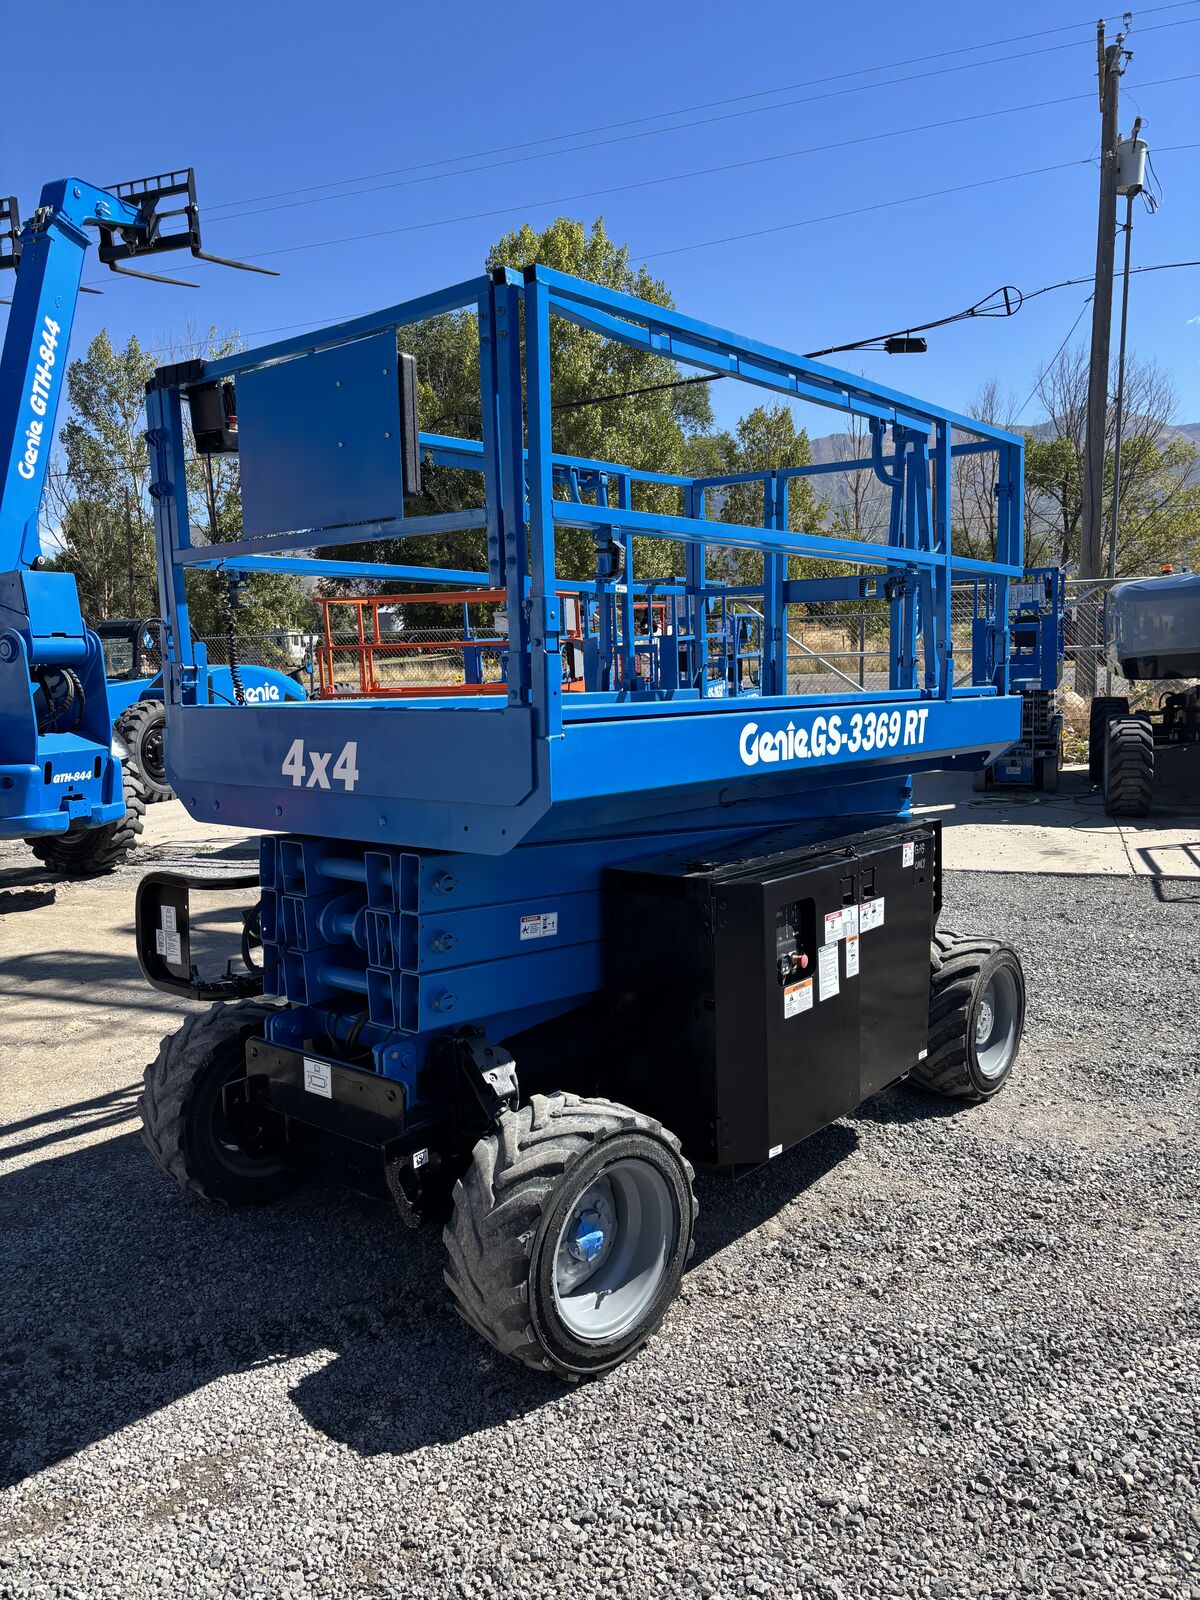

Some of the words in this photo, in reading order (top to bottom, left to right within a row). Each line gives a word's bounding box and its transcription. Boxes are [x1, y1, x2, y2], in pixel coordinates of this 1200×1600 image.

[30, 315, 61, 416] GTH-844
[18, 420, 43, 480] Genie
[281, 738, 360, 791] 4x4
[739, 721, 811, 766] Genie
[811, 714, 902, 758] GS-3369
[903, 708, 929, 746] RT
[53, 770, 92, 784] GTH-844
